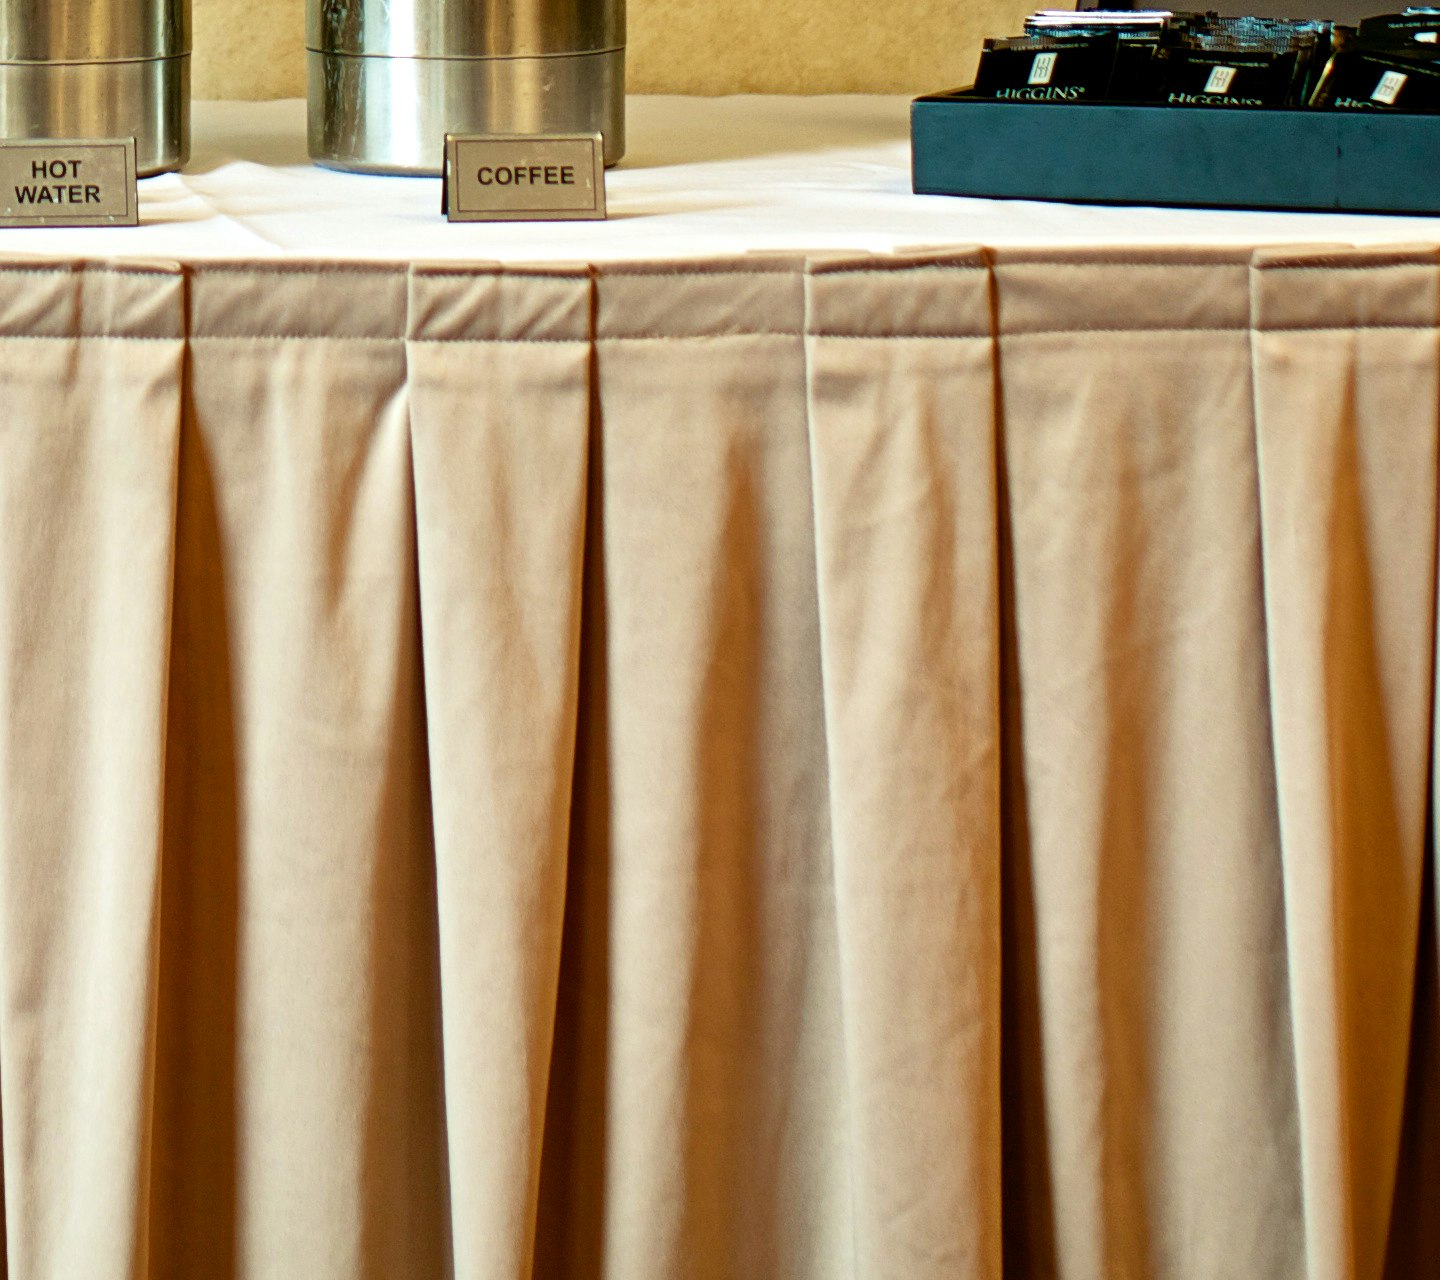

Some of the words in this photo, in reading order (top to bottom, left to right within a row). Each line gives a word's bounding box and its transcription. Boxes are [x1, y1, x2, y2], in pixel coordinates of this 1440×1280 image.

[31, 160, 82, 179] HOT
[477, 166, 575, 185] COFFEE
[15, 185, 101, 204] WATER
